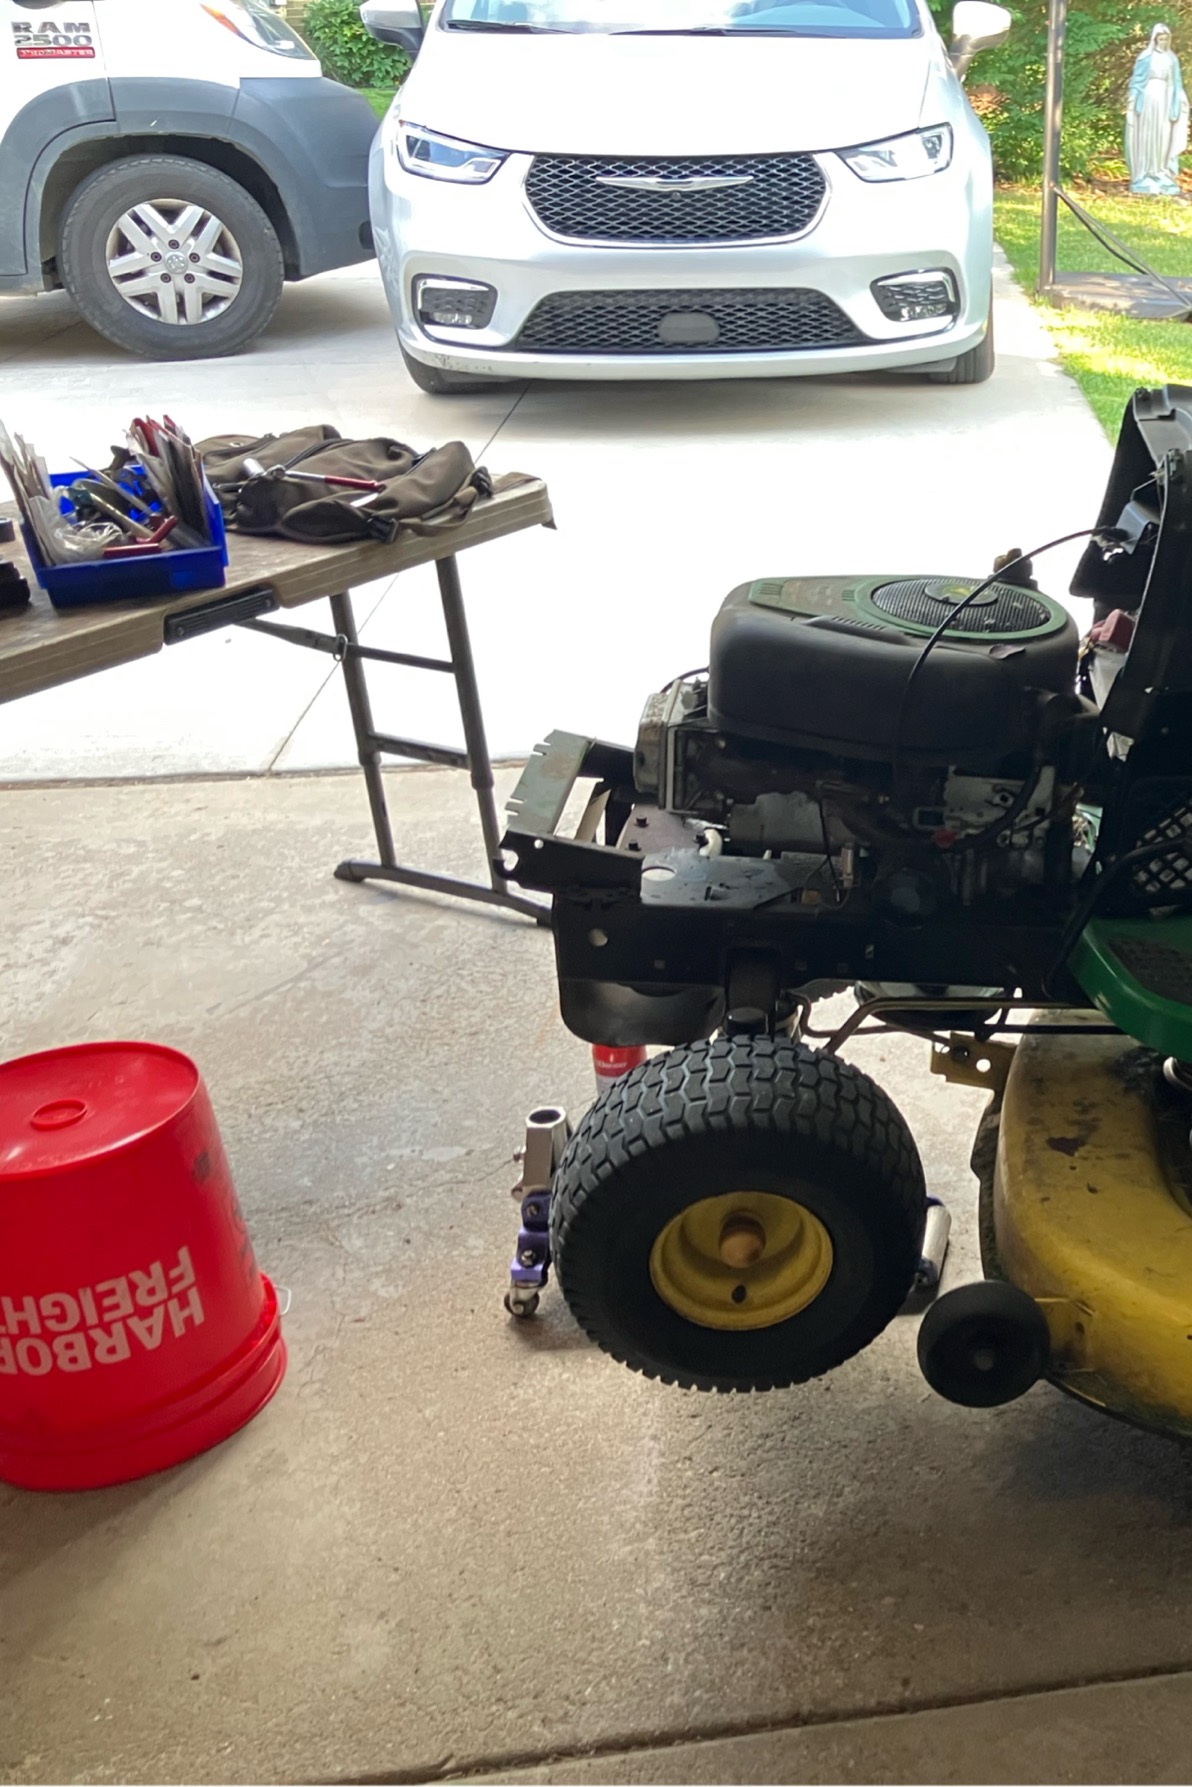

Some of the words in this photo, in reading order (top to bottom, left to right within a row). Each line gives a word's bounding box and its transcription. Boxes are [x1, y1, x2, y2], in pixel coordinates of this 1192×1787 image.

[11, 21, 91, 33] RAM
[14, 34, 92, 46] 2500
[0, 1245, 196, 1335] FREIGH
